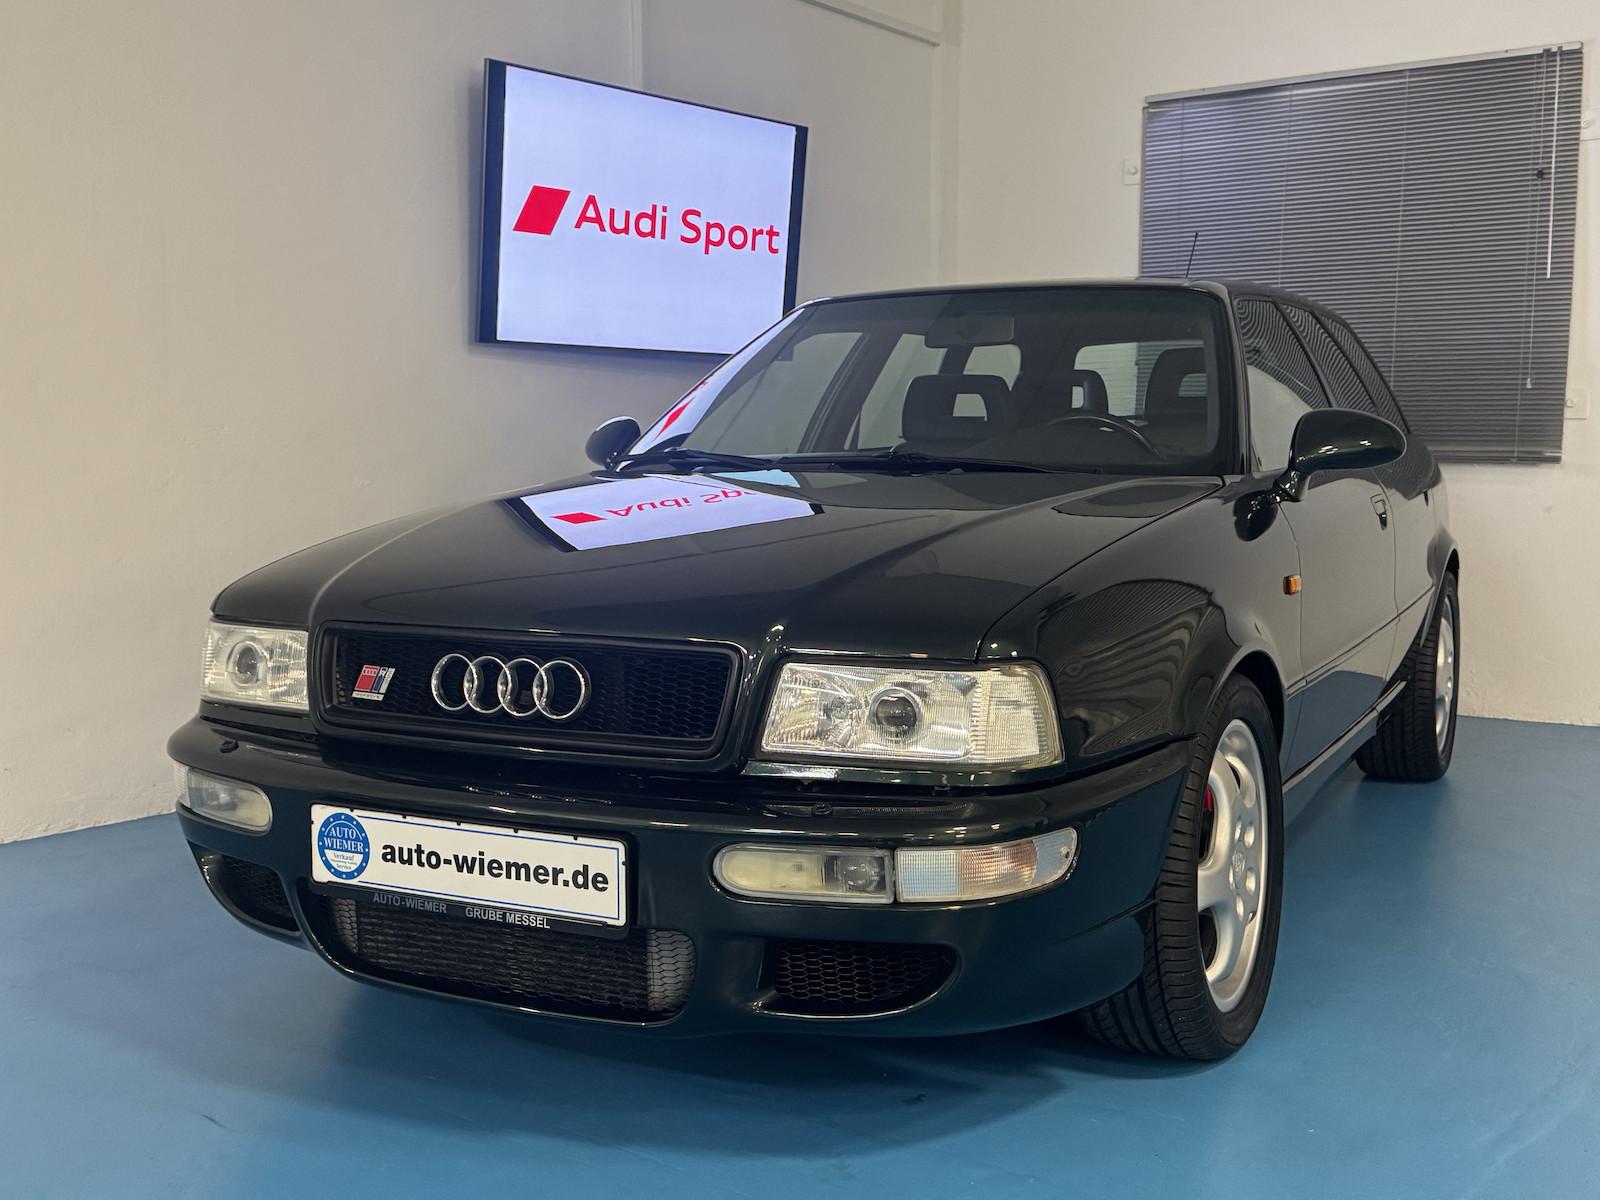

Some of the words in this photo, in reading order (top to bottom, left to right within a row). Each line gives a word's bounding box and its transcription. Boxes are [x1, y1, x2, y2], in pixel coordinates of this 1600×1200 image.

[574, 194, 668, 240] Audi
[680, 208, 780, 255] Sport
[323, 837, 364, 852] WIEMER
[330, 827, 357, 840] AUTO
[381, 843, 609, 892] auto-wiemer.de
[465, 906, 503, 922] GRUBE
[506, 913, 551, 929] MESSEL
